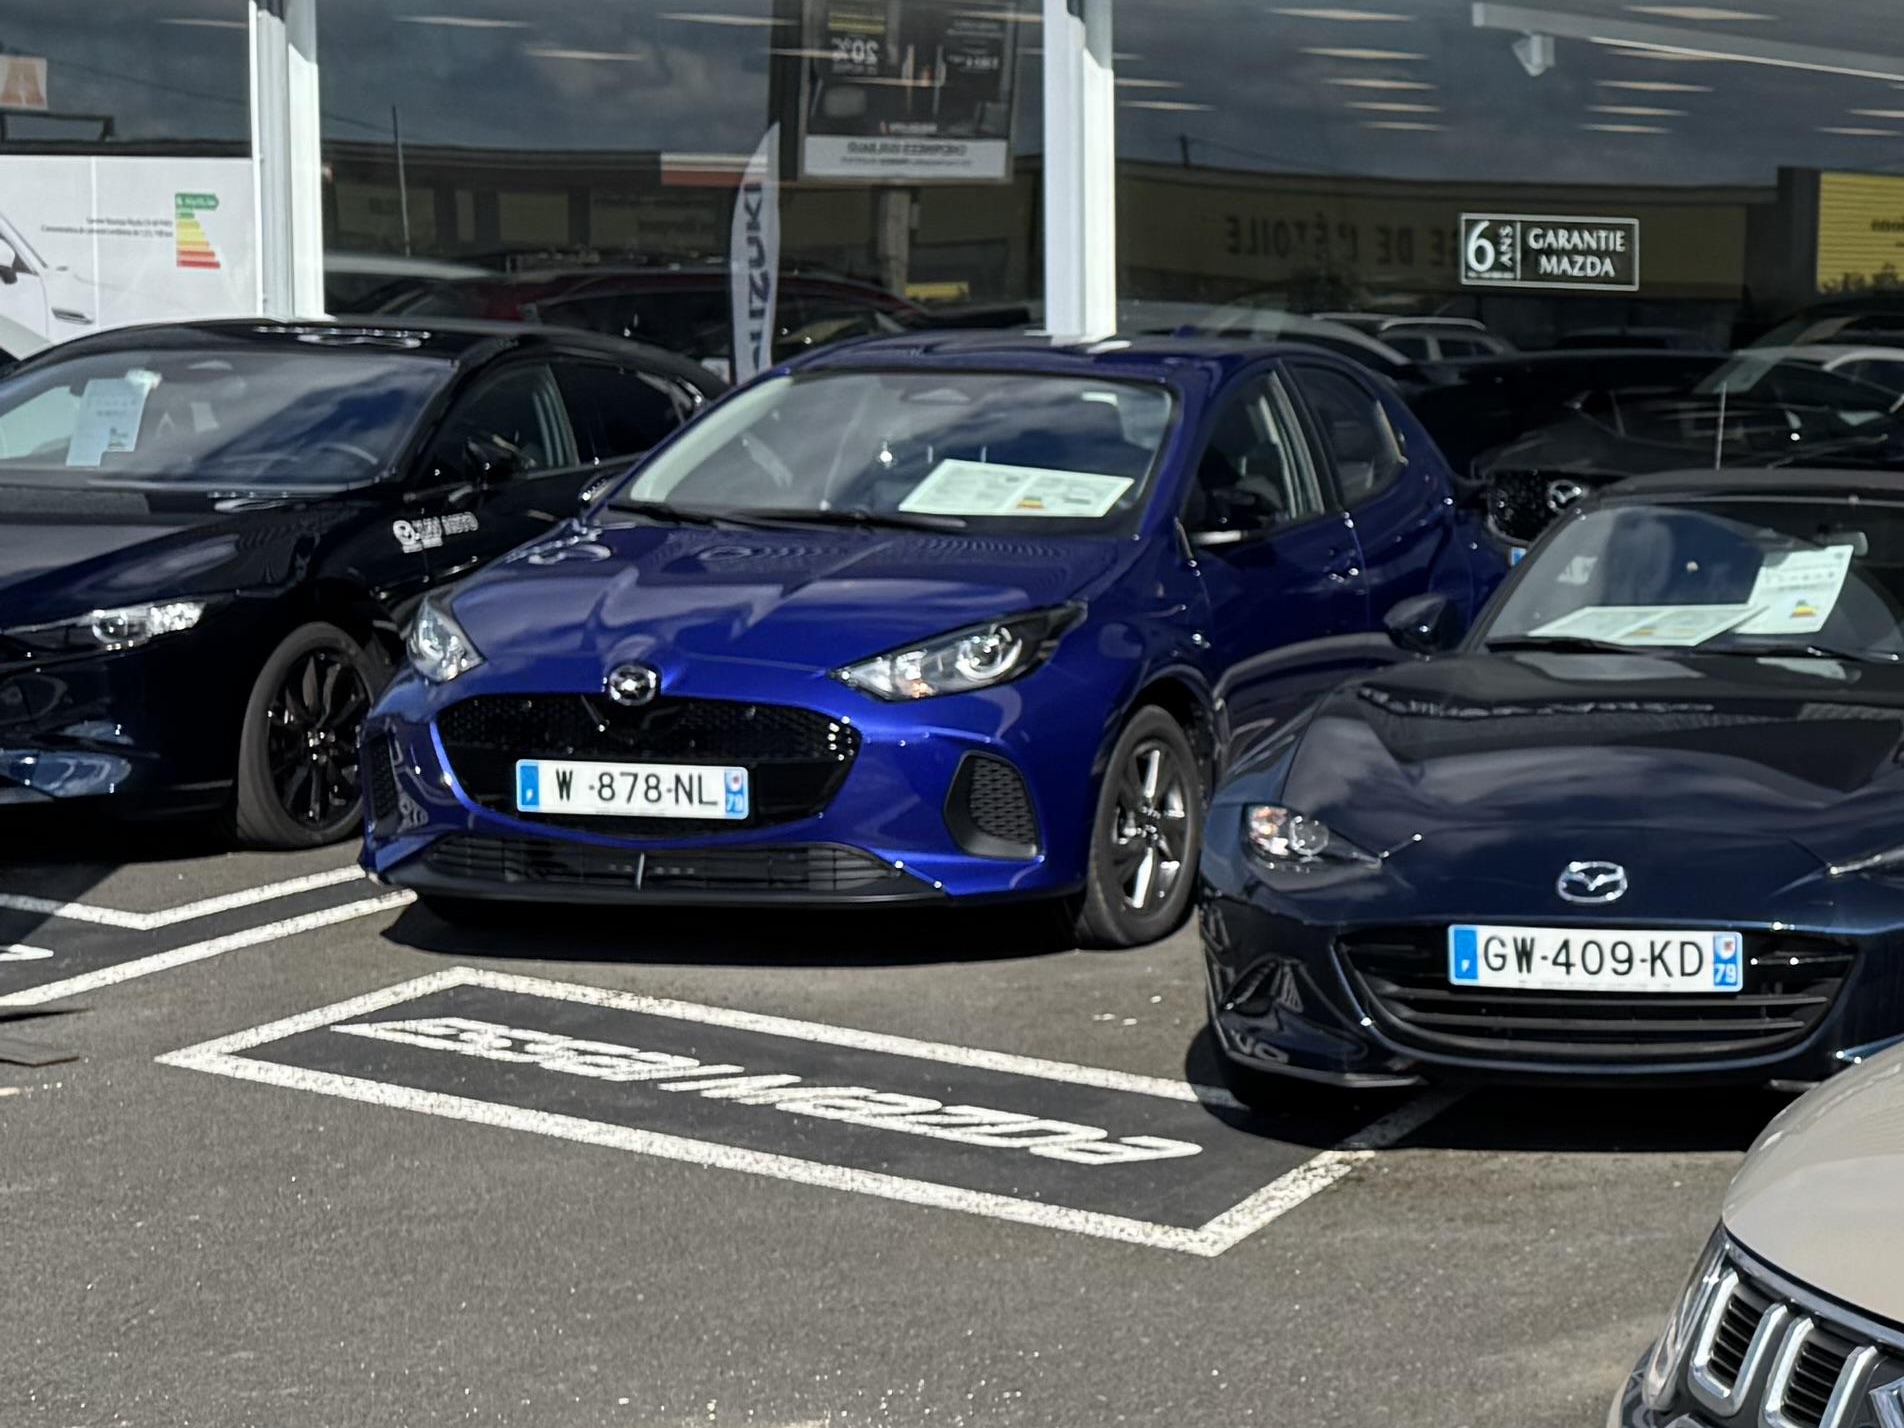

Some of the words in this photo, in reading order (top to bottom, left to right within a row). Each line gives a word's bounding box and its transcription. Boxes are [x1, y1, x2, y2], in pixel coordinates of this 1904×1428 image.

[1467, 220, 1496, 272] 6
[1499, 225, 1514, 268] ANS
[1527, 227, 1627, 253] GARANTIE
[1539, 254, 1617, 278] MAZDA
[1483, 935, 1704, 979] GW-409-KD
[1714, 963, 1737, 984] 79
